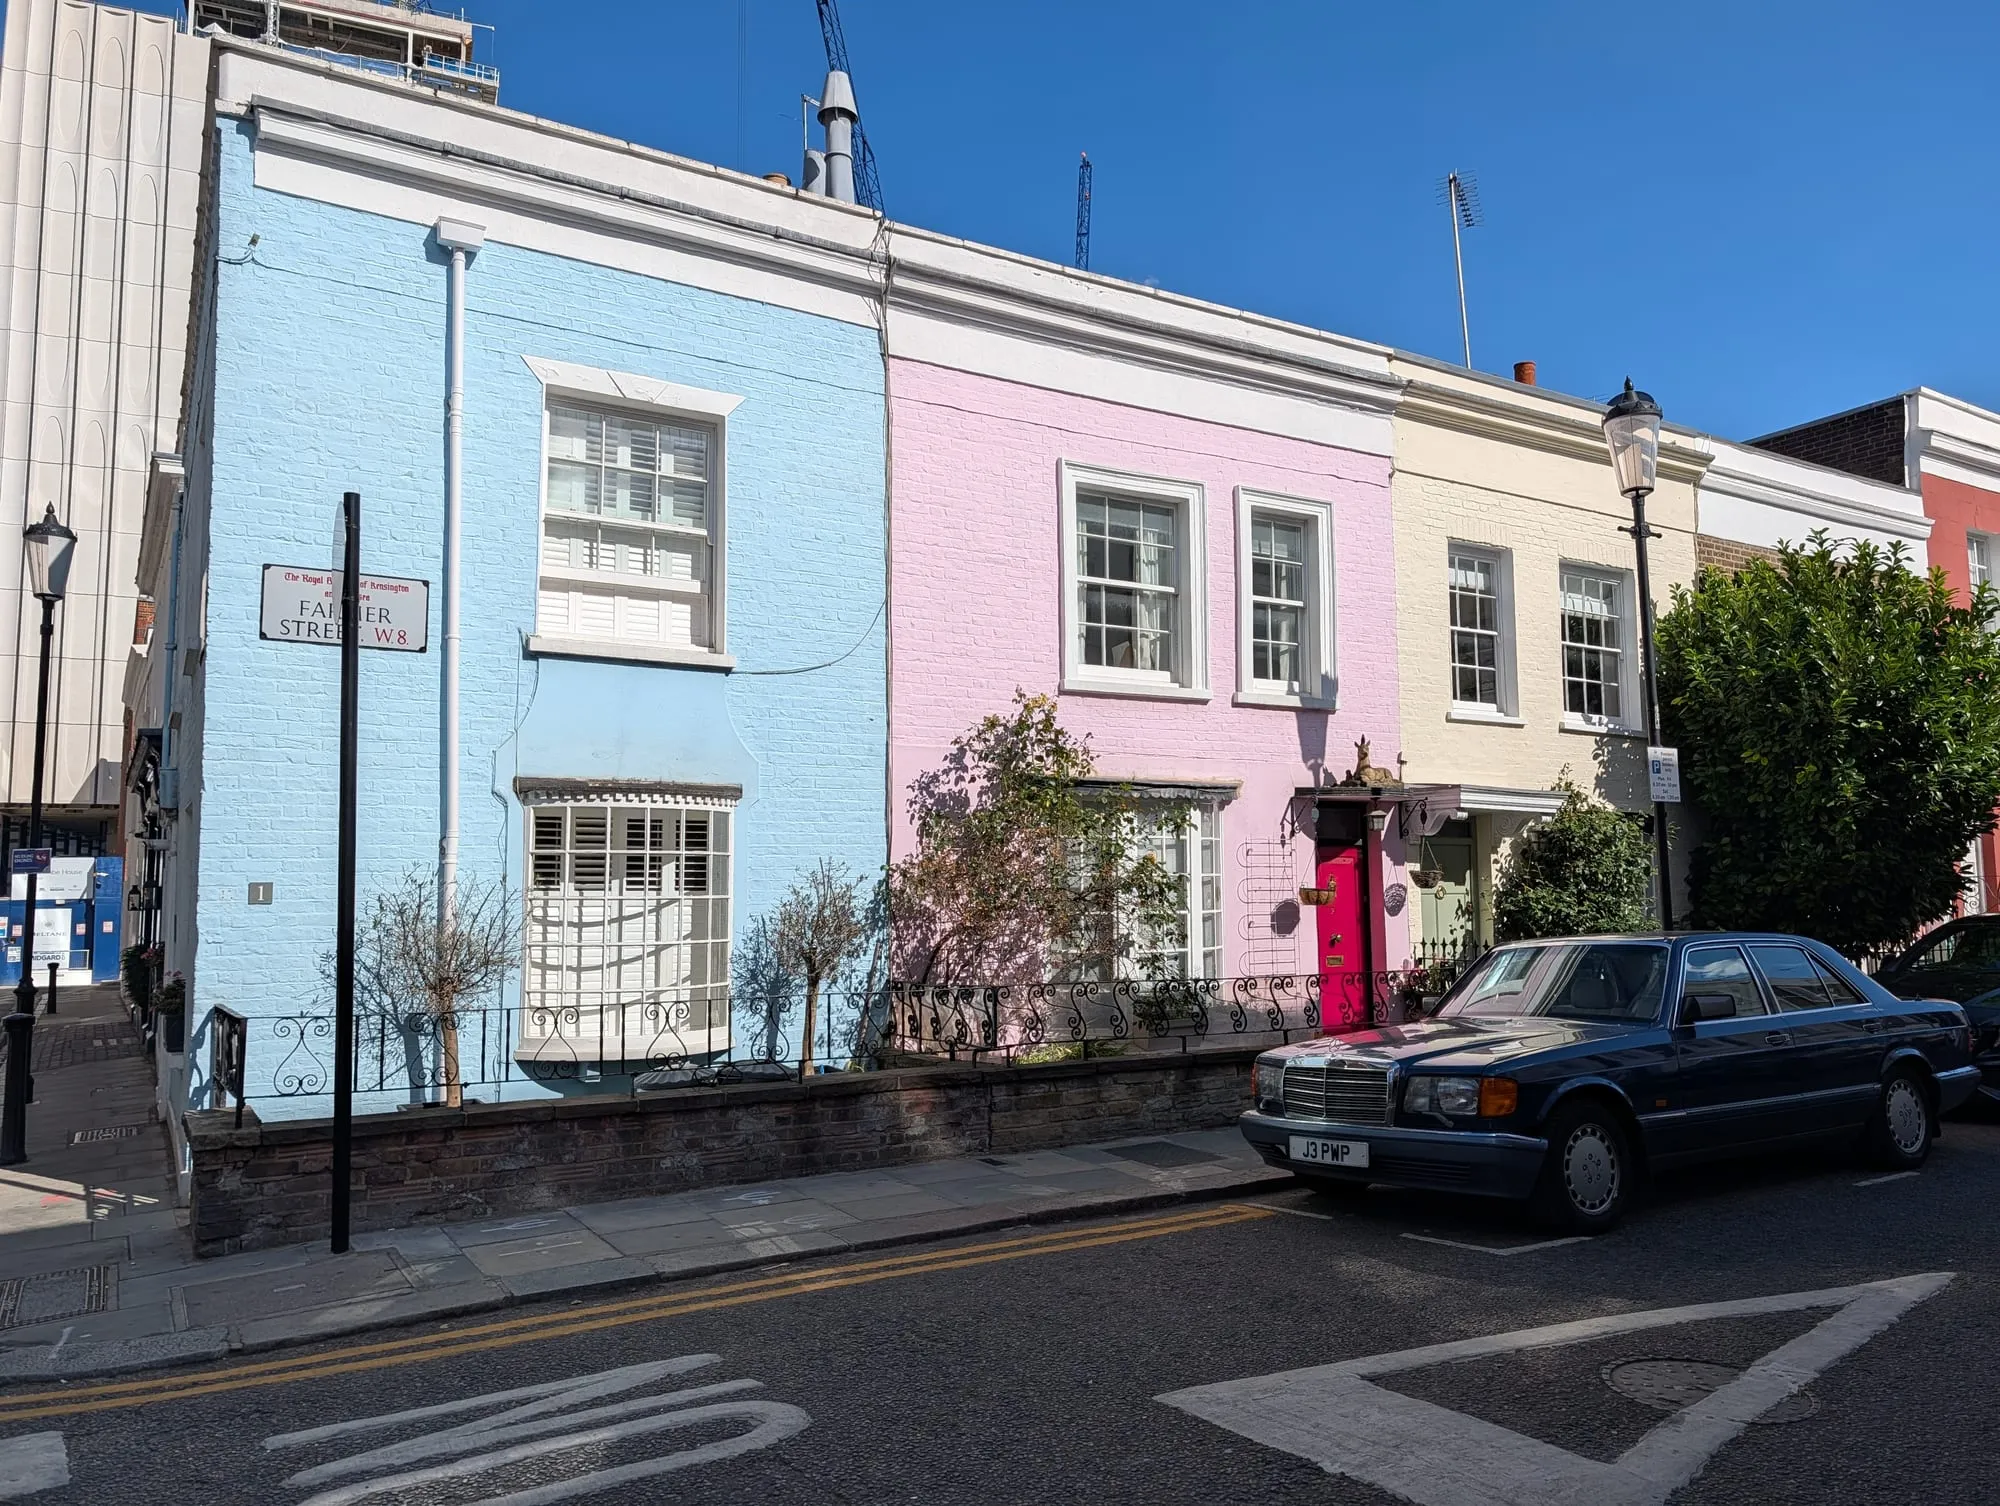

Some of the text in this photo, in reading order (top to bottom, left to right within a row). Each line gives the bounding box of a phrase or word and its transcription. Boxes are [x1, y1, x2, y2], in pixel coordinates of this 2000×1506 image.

[284, 572, 299, 582] The
[301, 574, 324, 586] Royal
[370, 581, 410, 594] Kensington
[257, 885, 265, 901] 1
[1302, 1140, 1350, 1162] J3 PWP
